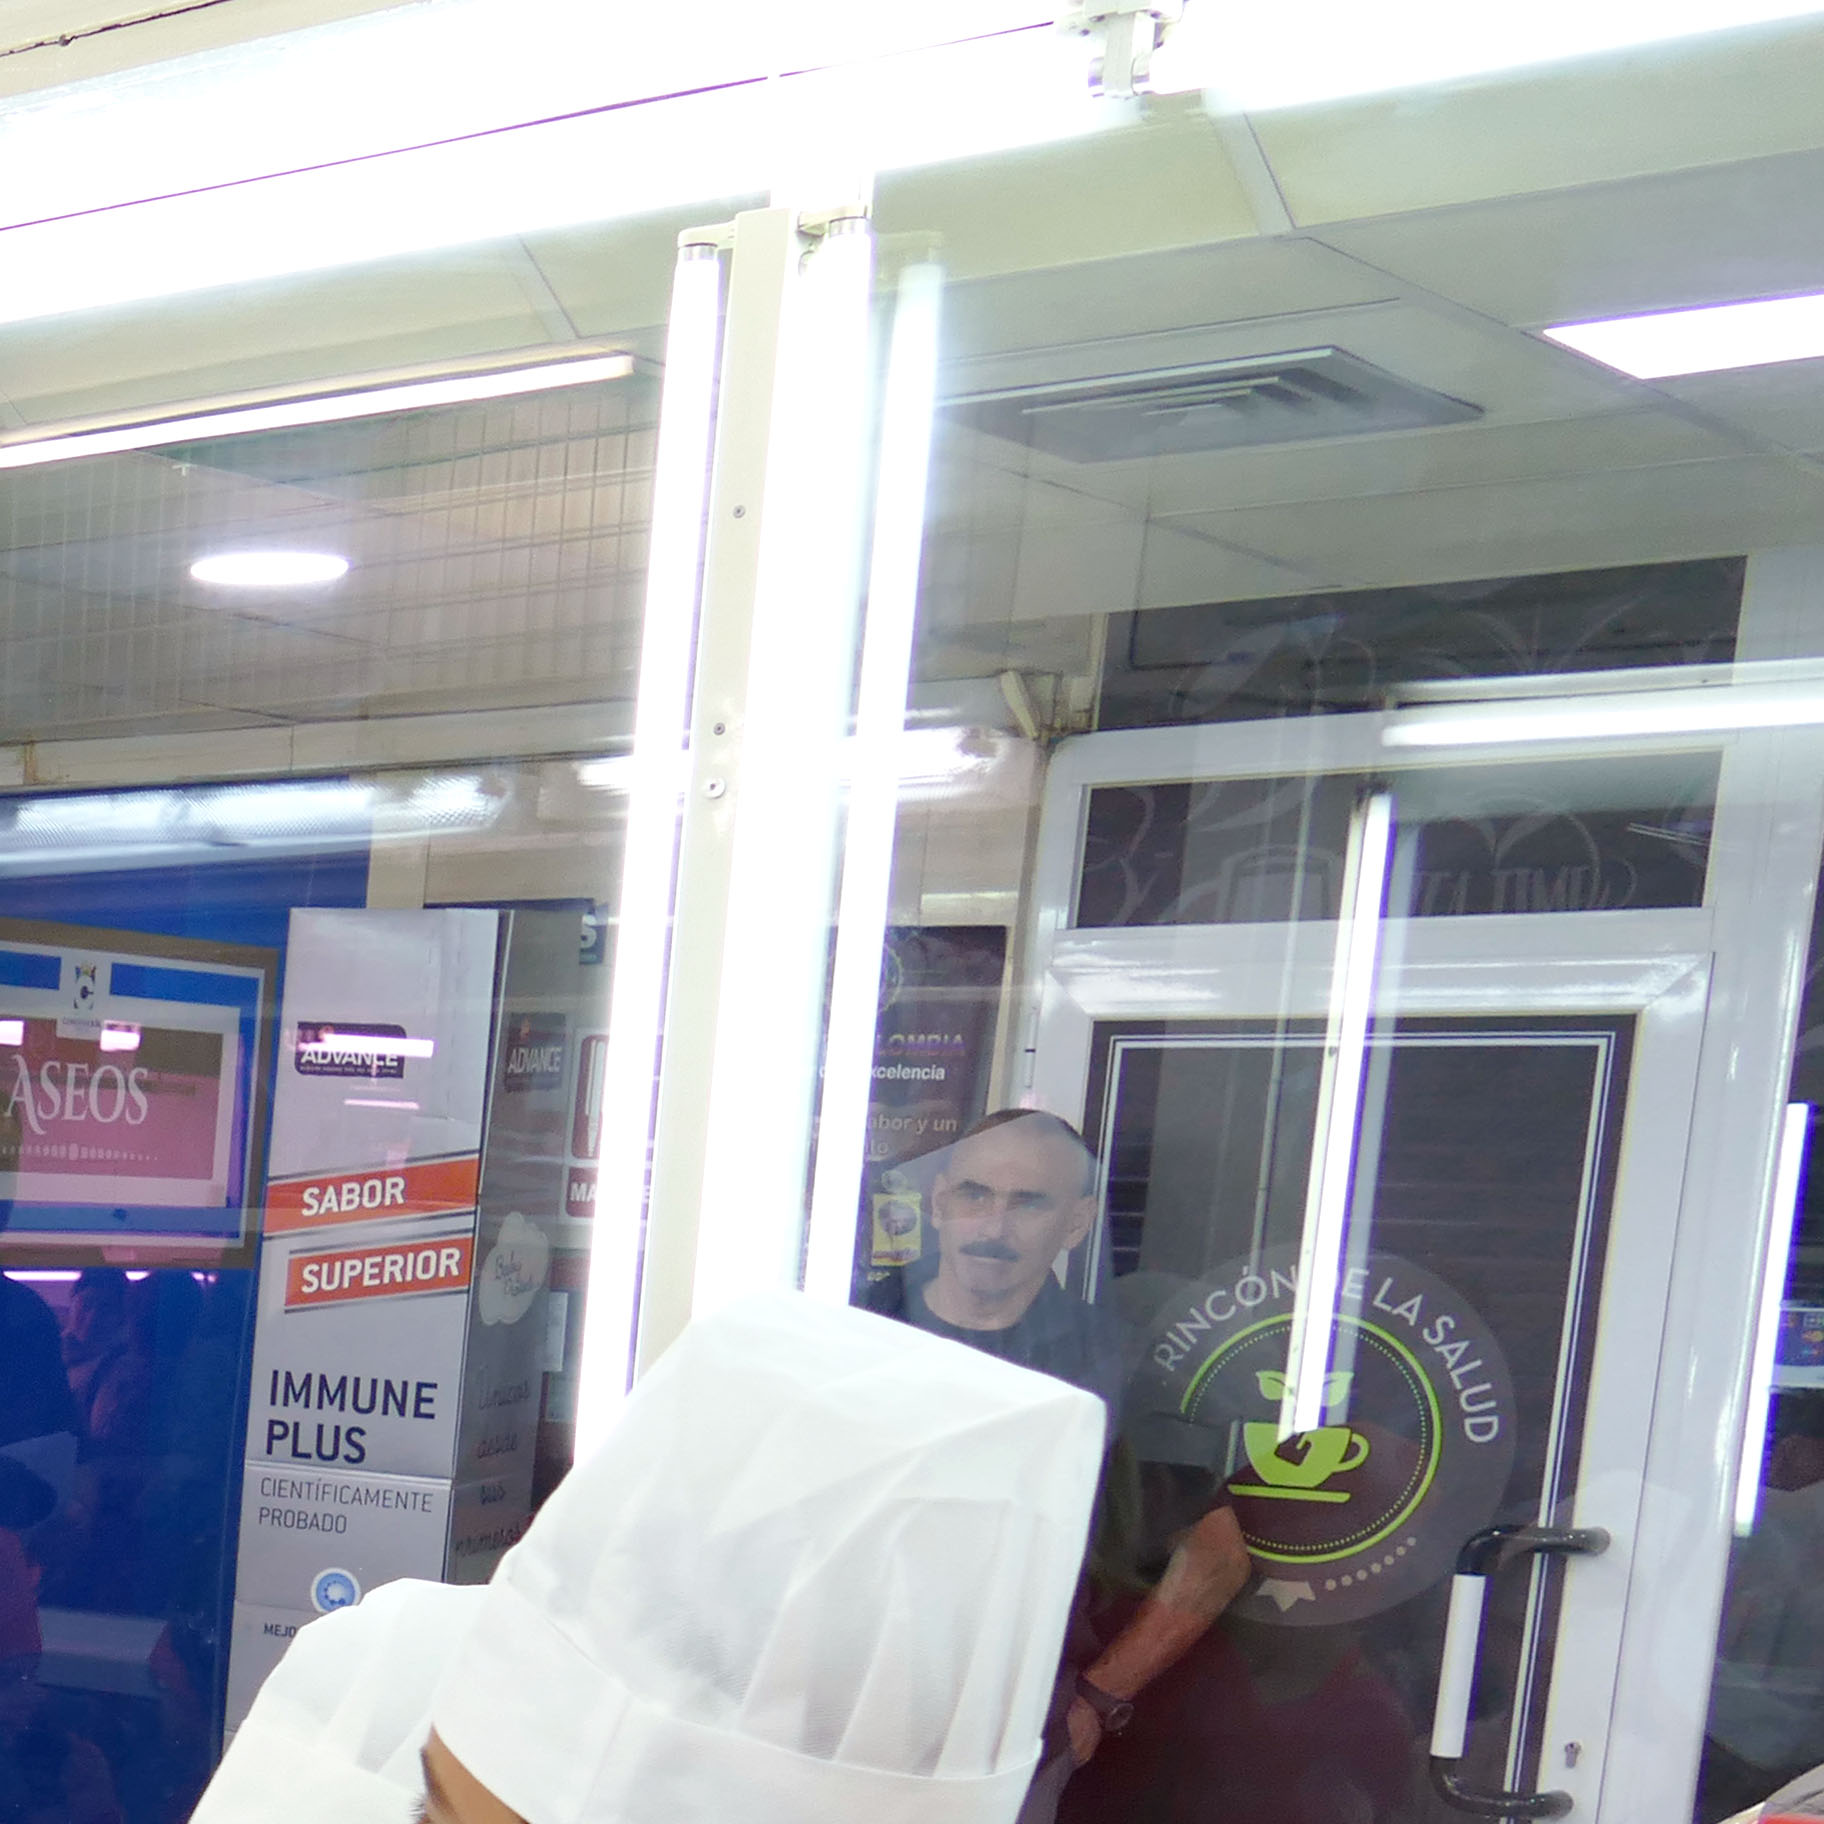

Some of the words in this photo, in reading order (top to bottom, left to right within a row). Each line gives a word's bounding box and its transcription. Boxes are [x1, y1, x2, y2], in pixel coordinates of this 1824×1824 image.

[507, 1046, 562, 1074] ADVANCE
[871, 1063, 946, 1081] xcelencia
[4, 1054, 149, 1135] ASEOS
[301, 1176, 406, 1217] SABOR
[301, 1247, 461, 1294] SUPERIOR
[1153, 1265, 1297, 1371] RINCÓN
[1340, 1267, 1370, 1300] E
[1372, 1277, 1424, 1327] LA
[1422, 1315, 1499, 1443] SALUD
[268, 1368, 439, 1420] IMMUNE
[265, 1419, 367, 1465] PLUS
[259, 1476, 434, 1514] CIENTÍFICAMENTE
[258, 1506, 348, 1535] PROBADO
[263, 1623, 297, 1639] MEJO
